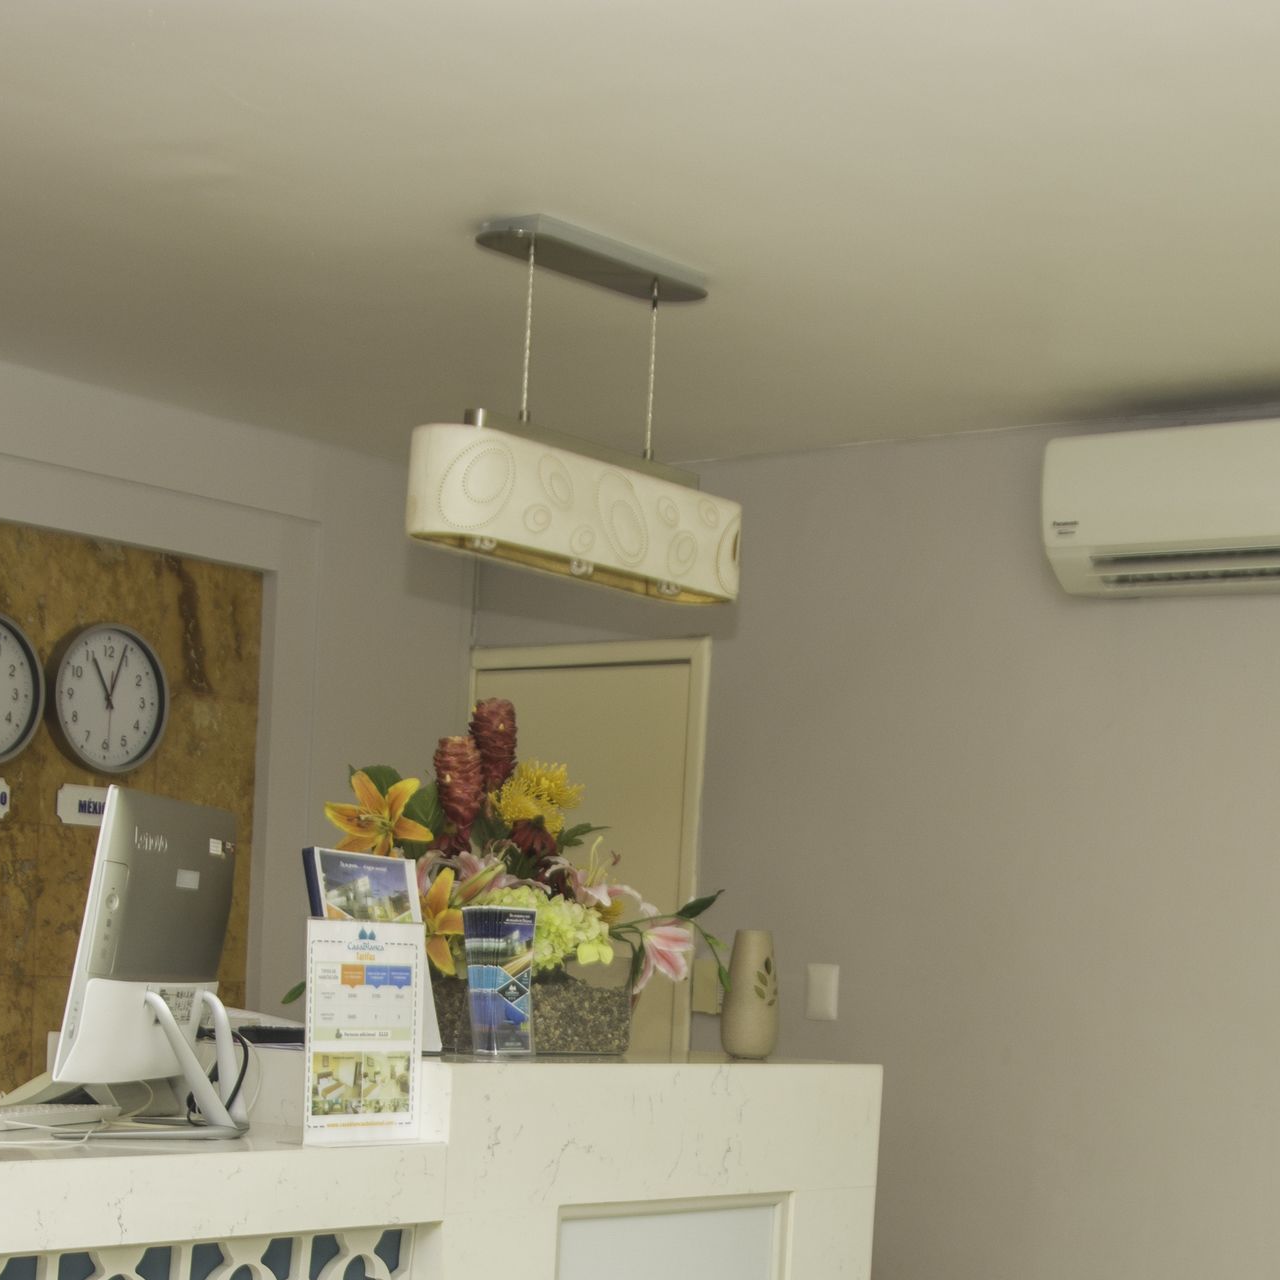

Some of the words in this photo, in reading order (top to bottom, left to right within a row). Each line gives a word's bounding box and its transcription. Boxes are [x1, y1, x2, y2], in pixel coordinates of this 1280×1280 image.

[103, 644, 115, 659] 12
[8, 663, 16, 678] 2
[71, 664, 83, 679] 10
[135, 673, 142, 688] 2
[12, 688, 19, 701] 3
[66, 686, 74, 700] 9
[139, 696, 146, 710] 3
[4, 710, 12, 723] 4
[71, 710, 78, 723] 8
[132, 719, 140, 732] 4
[84, 729, 91, 742] 7
[120, 735, 128, 748] 5
[101, 738, 109, 751] 6
